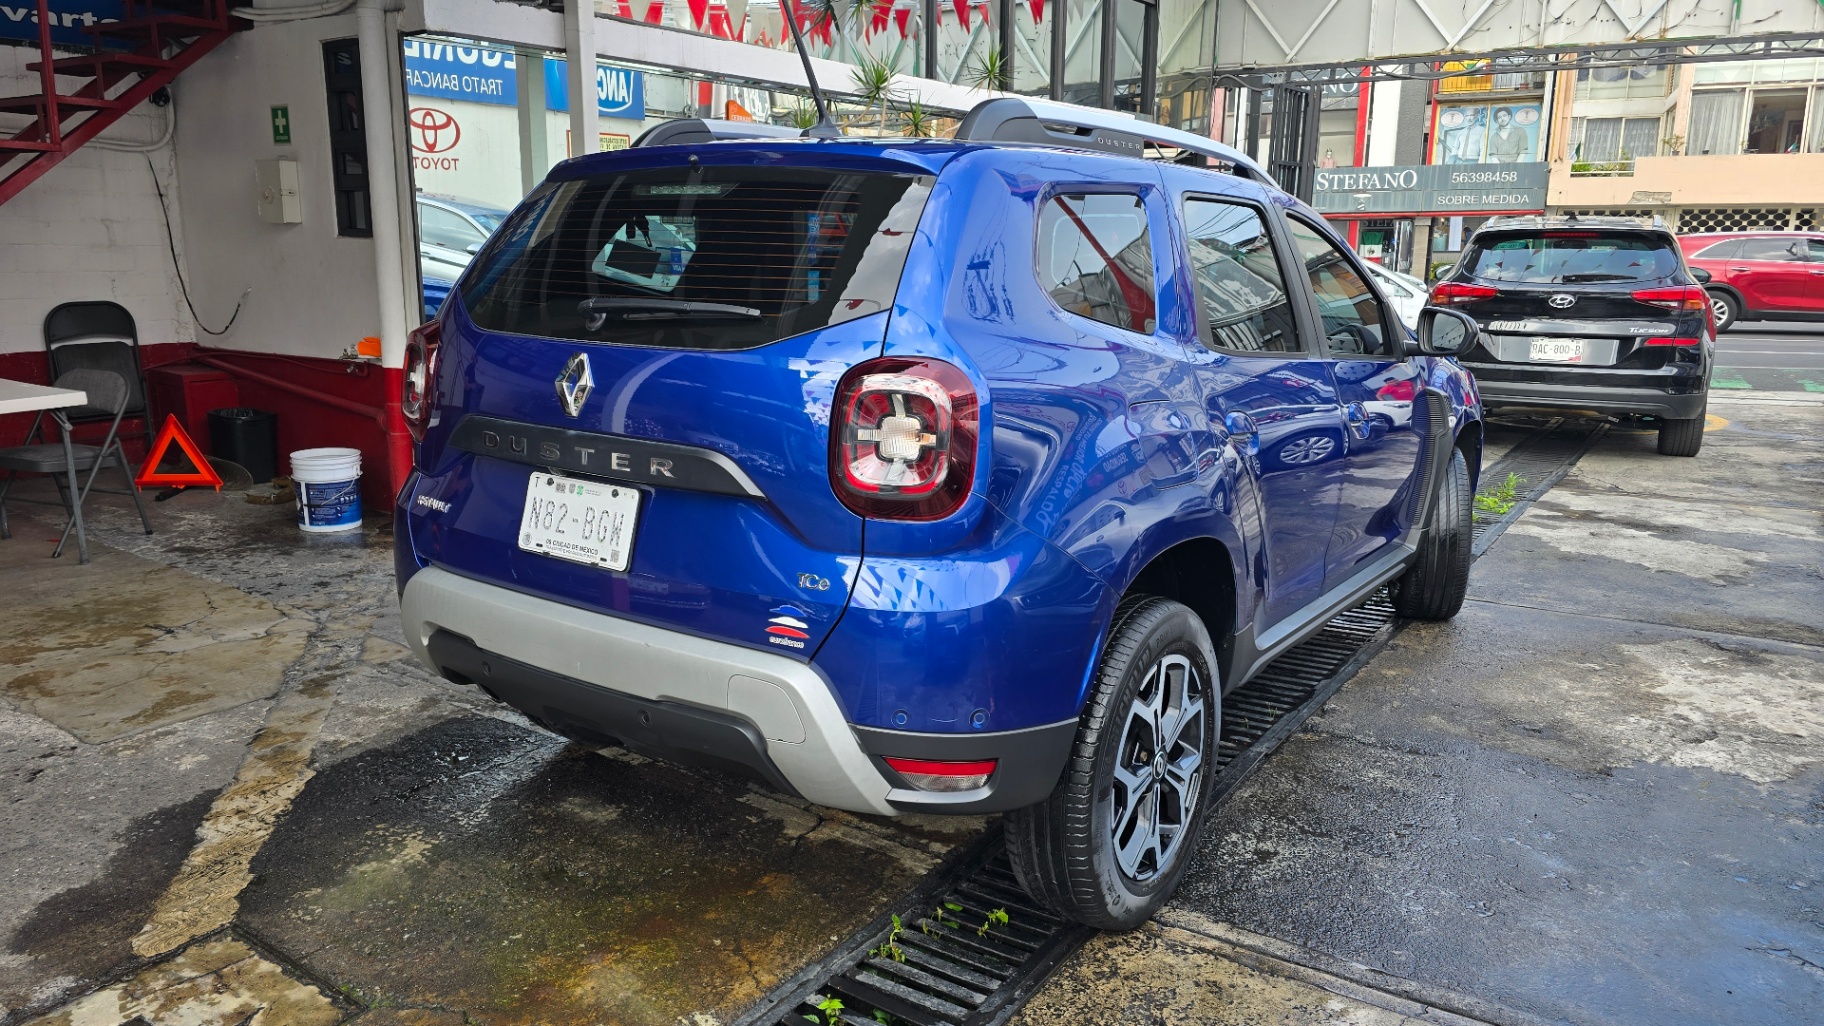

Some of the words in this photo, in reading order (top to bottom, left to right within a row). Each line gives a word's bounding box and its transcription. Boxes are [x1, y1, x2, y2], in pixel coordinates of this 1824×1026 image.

[1097, 137, 1141, 151] DUSTER
[1316, 169, 1418, 191] STEFANO
[1451, 171, 1518, 184] 56398458
[1437, 195, 1479, 205] SOBRE
[1482, 194, 1530, 204] MEDIDA
[483, 431, 675, 478] DUSTER
[796, 572, 831, 591] TCe
